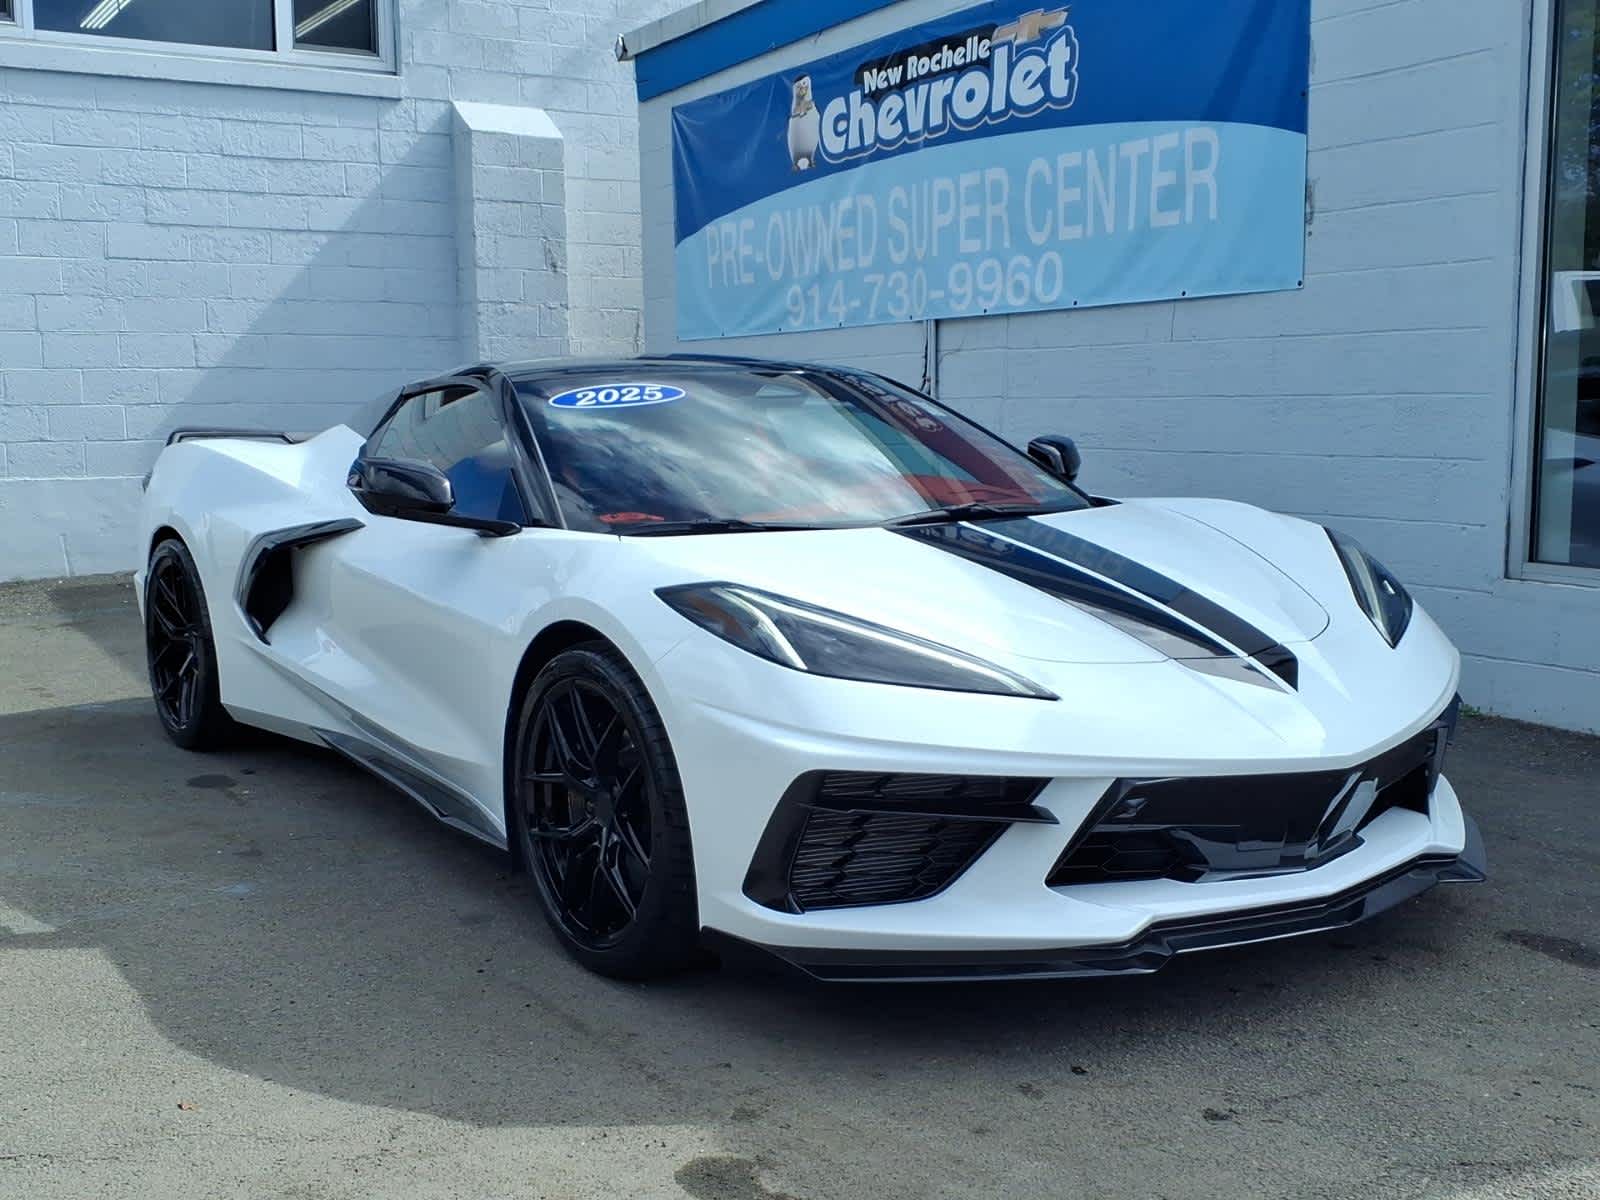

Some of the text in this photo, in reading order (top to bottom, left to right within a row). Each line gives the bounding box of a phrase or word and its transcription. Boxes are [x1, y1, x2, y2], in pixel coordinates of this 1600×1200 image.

[820, 34, 1072, 156] Chevrolet
[863, 35, 991, 94] New Rochelle
[705, 126, 1220, 289] PRE-OWNED SUPER CENTER
[784, 250, 1065, 327] 914-730-9960
[575, 386, 664, 407] 2025
